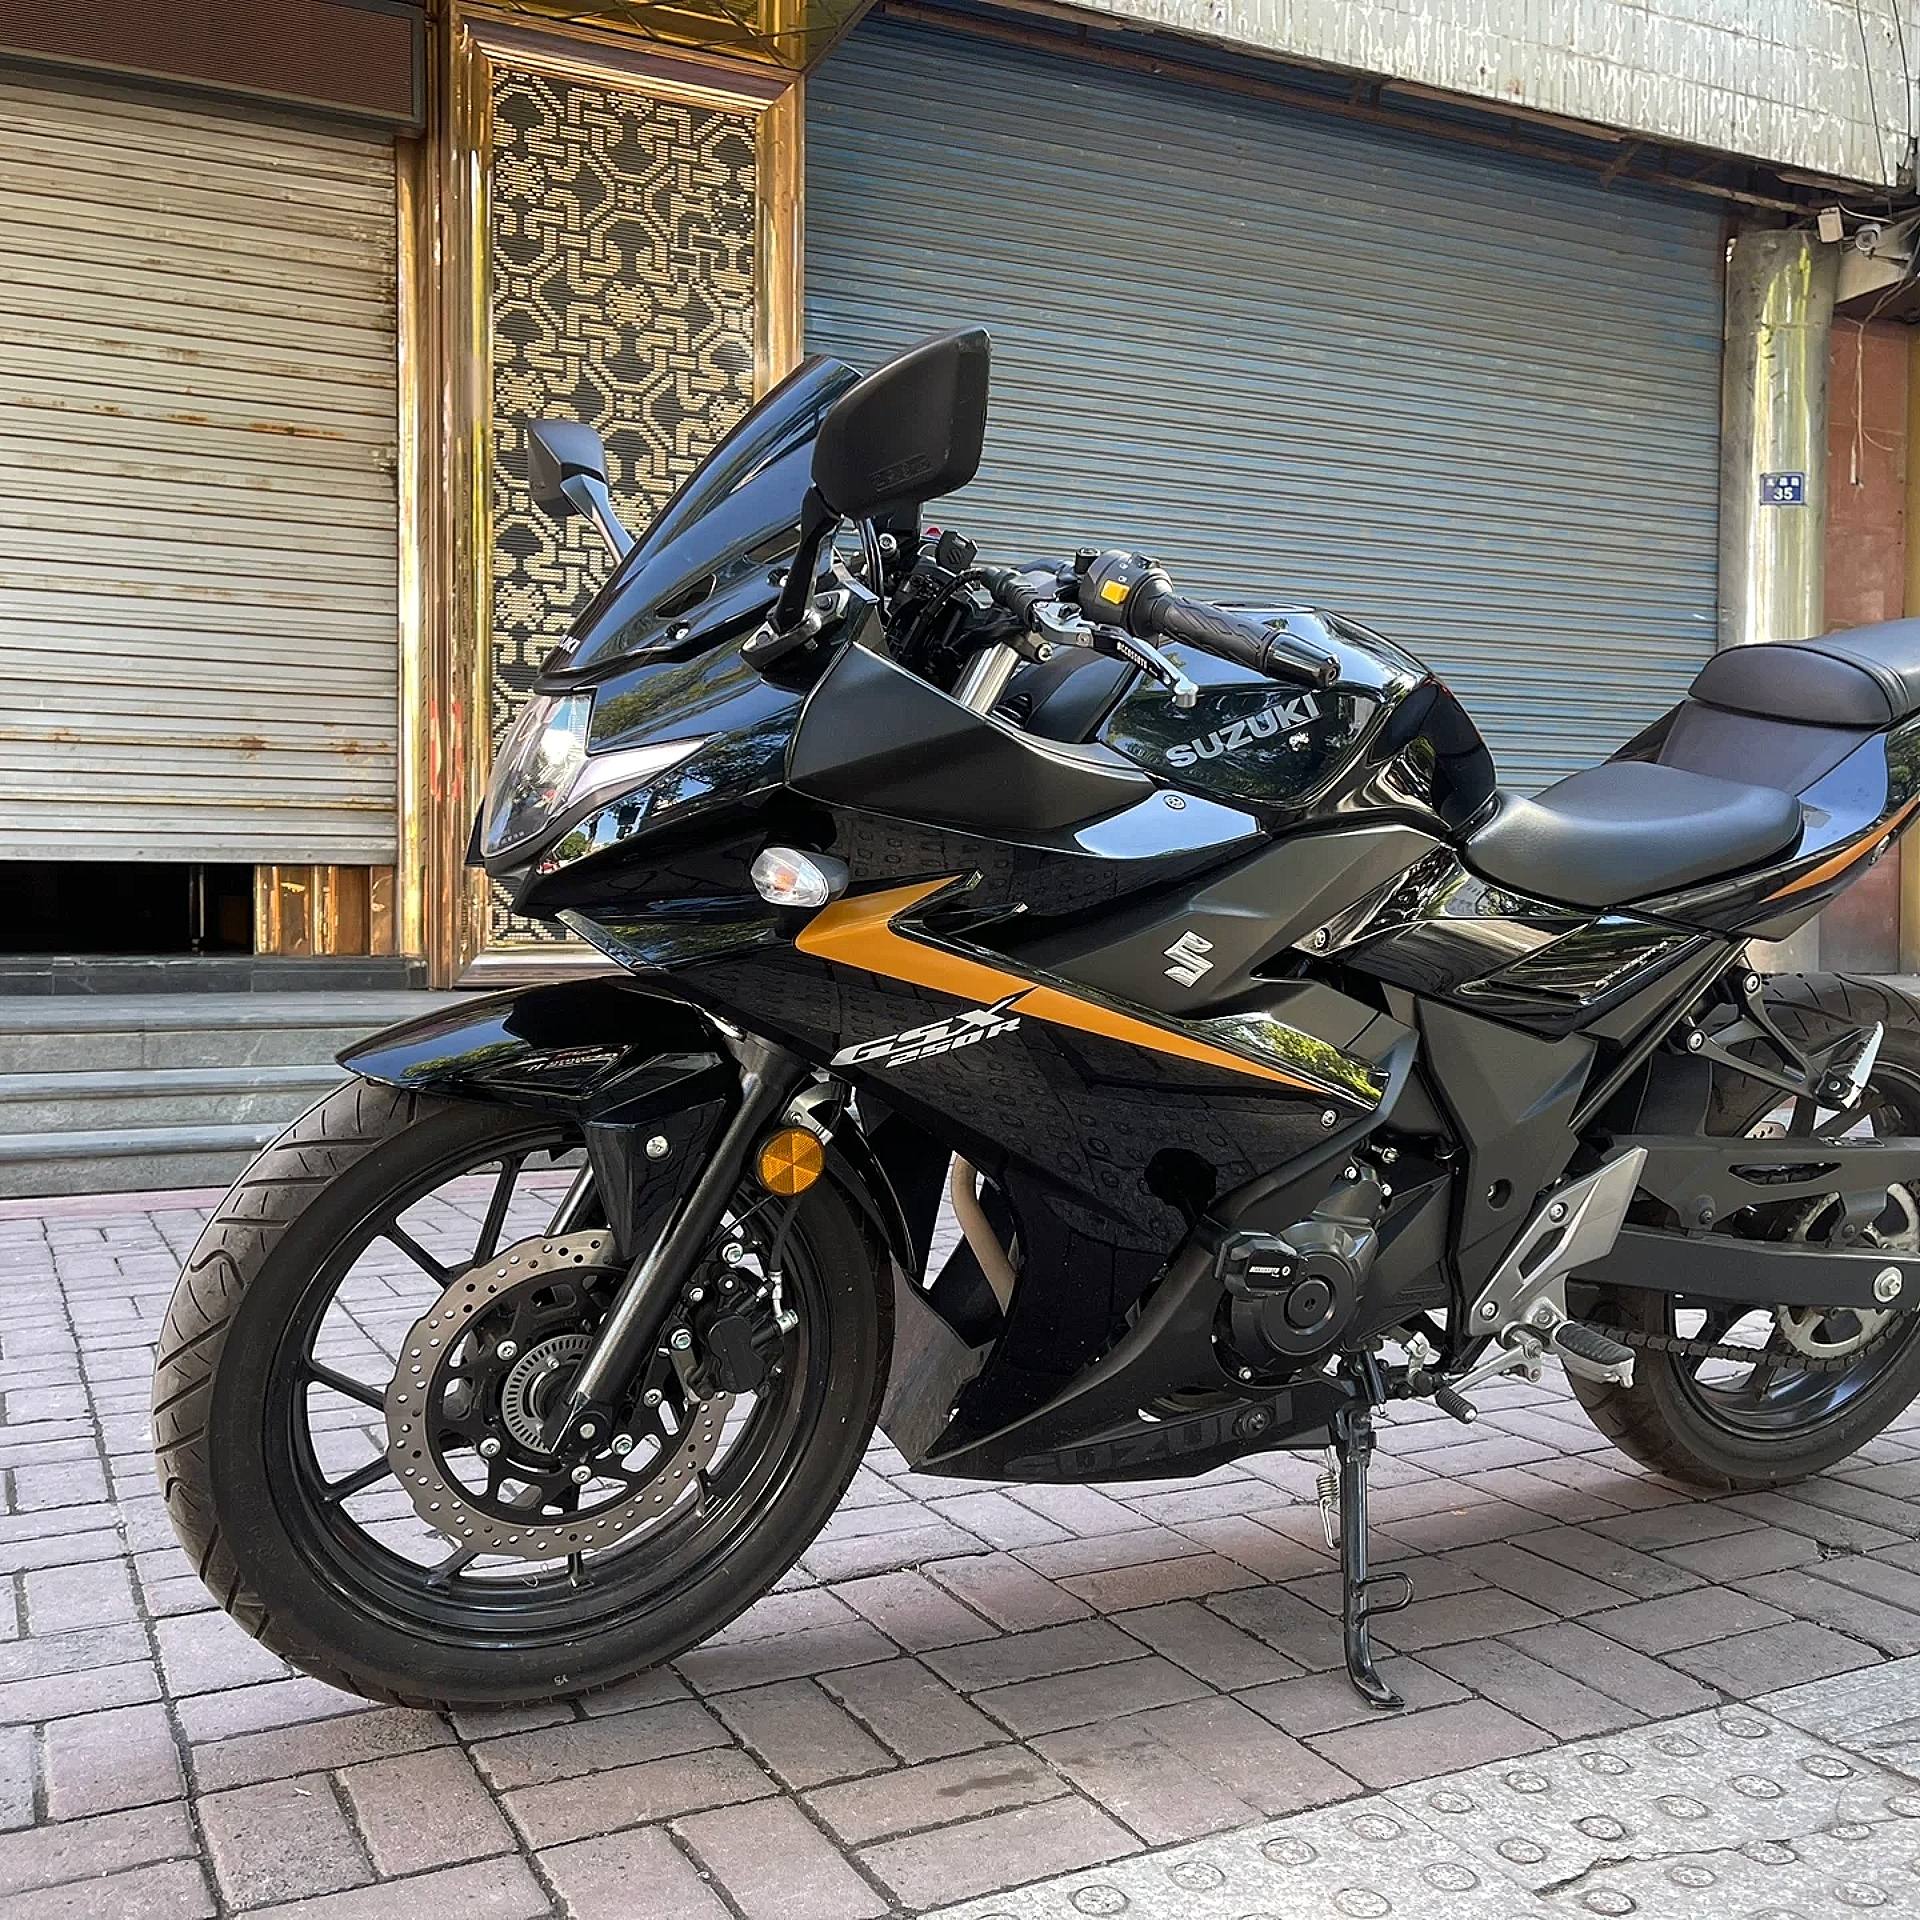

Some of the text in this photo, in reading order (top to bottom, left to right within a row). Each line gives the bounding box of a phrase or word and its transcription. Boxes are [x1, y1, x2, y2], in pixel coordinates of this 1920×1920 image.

[1773, 487, 1793, 500] 35
[1165, 691, 1321, 768] SUZUKI
[829, 996, 1017, 1067] GSX
[884, 1016, 1021, 1069] 250R
